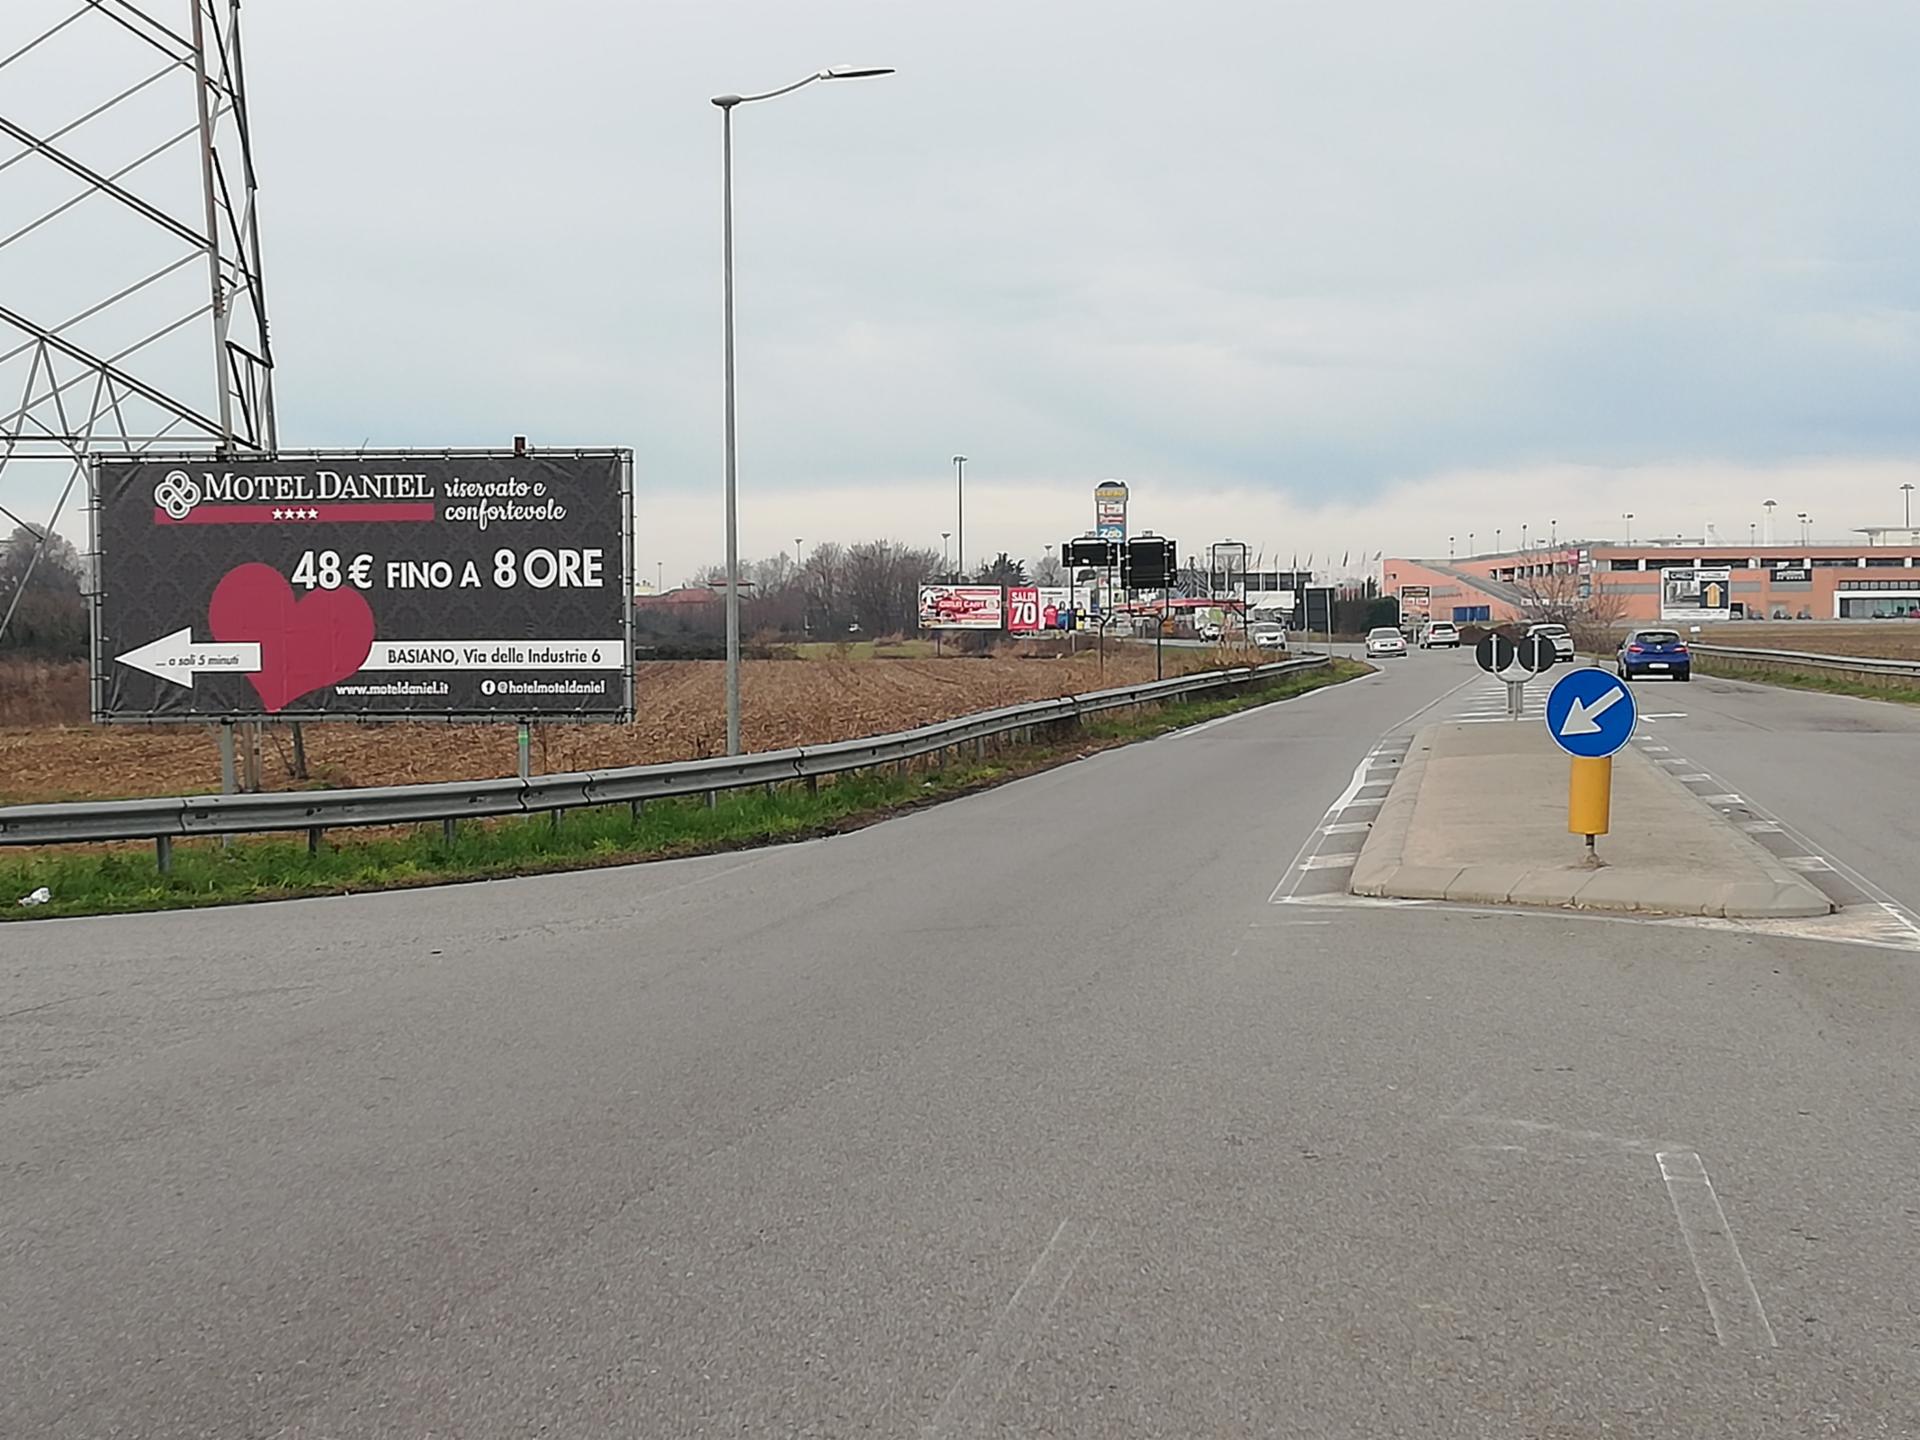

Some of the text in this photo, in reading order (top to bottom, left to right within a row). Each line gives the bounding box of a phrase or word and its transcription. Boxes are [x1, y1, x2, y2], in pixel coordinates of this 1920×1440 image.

[203, 471, 435, 500] MOTEL DANIEL
[444, 477, 546, 497] riservato e
[444, 498, 567, 531] confortevole
[291, 549, 603, 590] 48 € FINO A 8 ORE
[1011, 603, 1037, 625] 70
[178, 654, 196, 666] soli
[197, 654, 206, 666] 5
[208, 654, 240, 666] minuti
[388, 647, 601, 665] BASIANO, Via delle Industrie 6
[335, 681, 449, 695] www.moteldaniel.it
[497, 680, 605, 695] @hotelmoteldaniel
